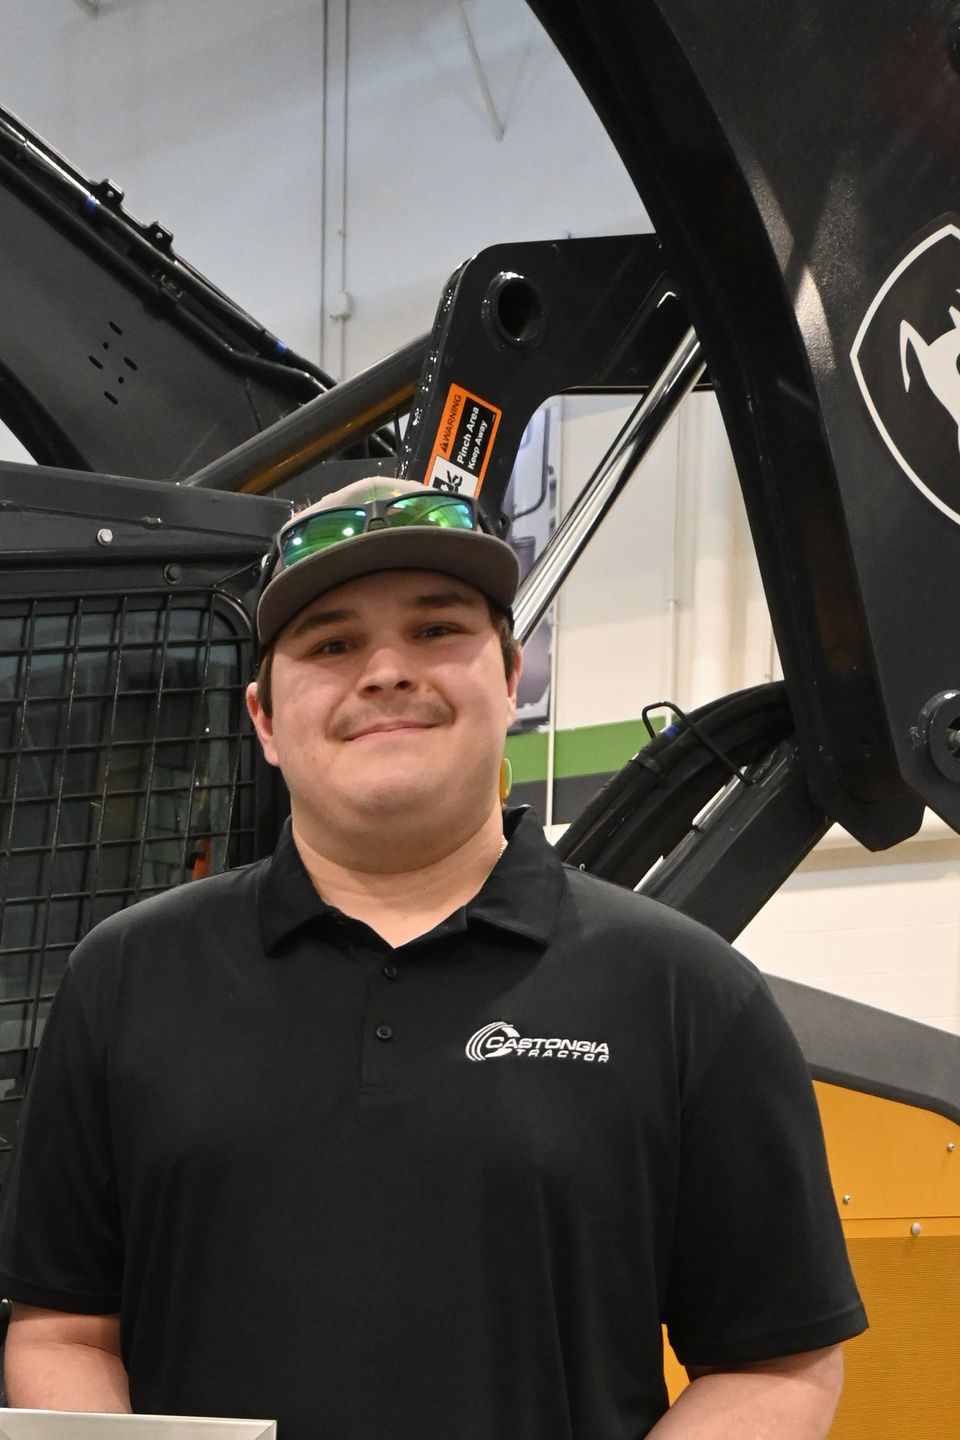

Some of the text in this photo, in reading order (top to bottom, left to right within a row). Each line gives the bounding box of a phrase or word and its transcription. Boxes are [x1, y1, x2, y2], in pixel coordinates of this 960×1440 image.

[443, 394, 462, 440] WARNING
[456, 407, 479, 464] Pinch Area
[467, 420, 488, 470] Keep Away
[485, 1036, 610, 1055] CASTONGIA
[516, 1048, 610, 1063] TRACTOR
